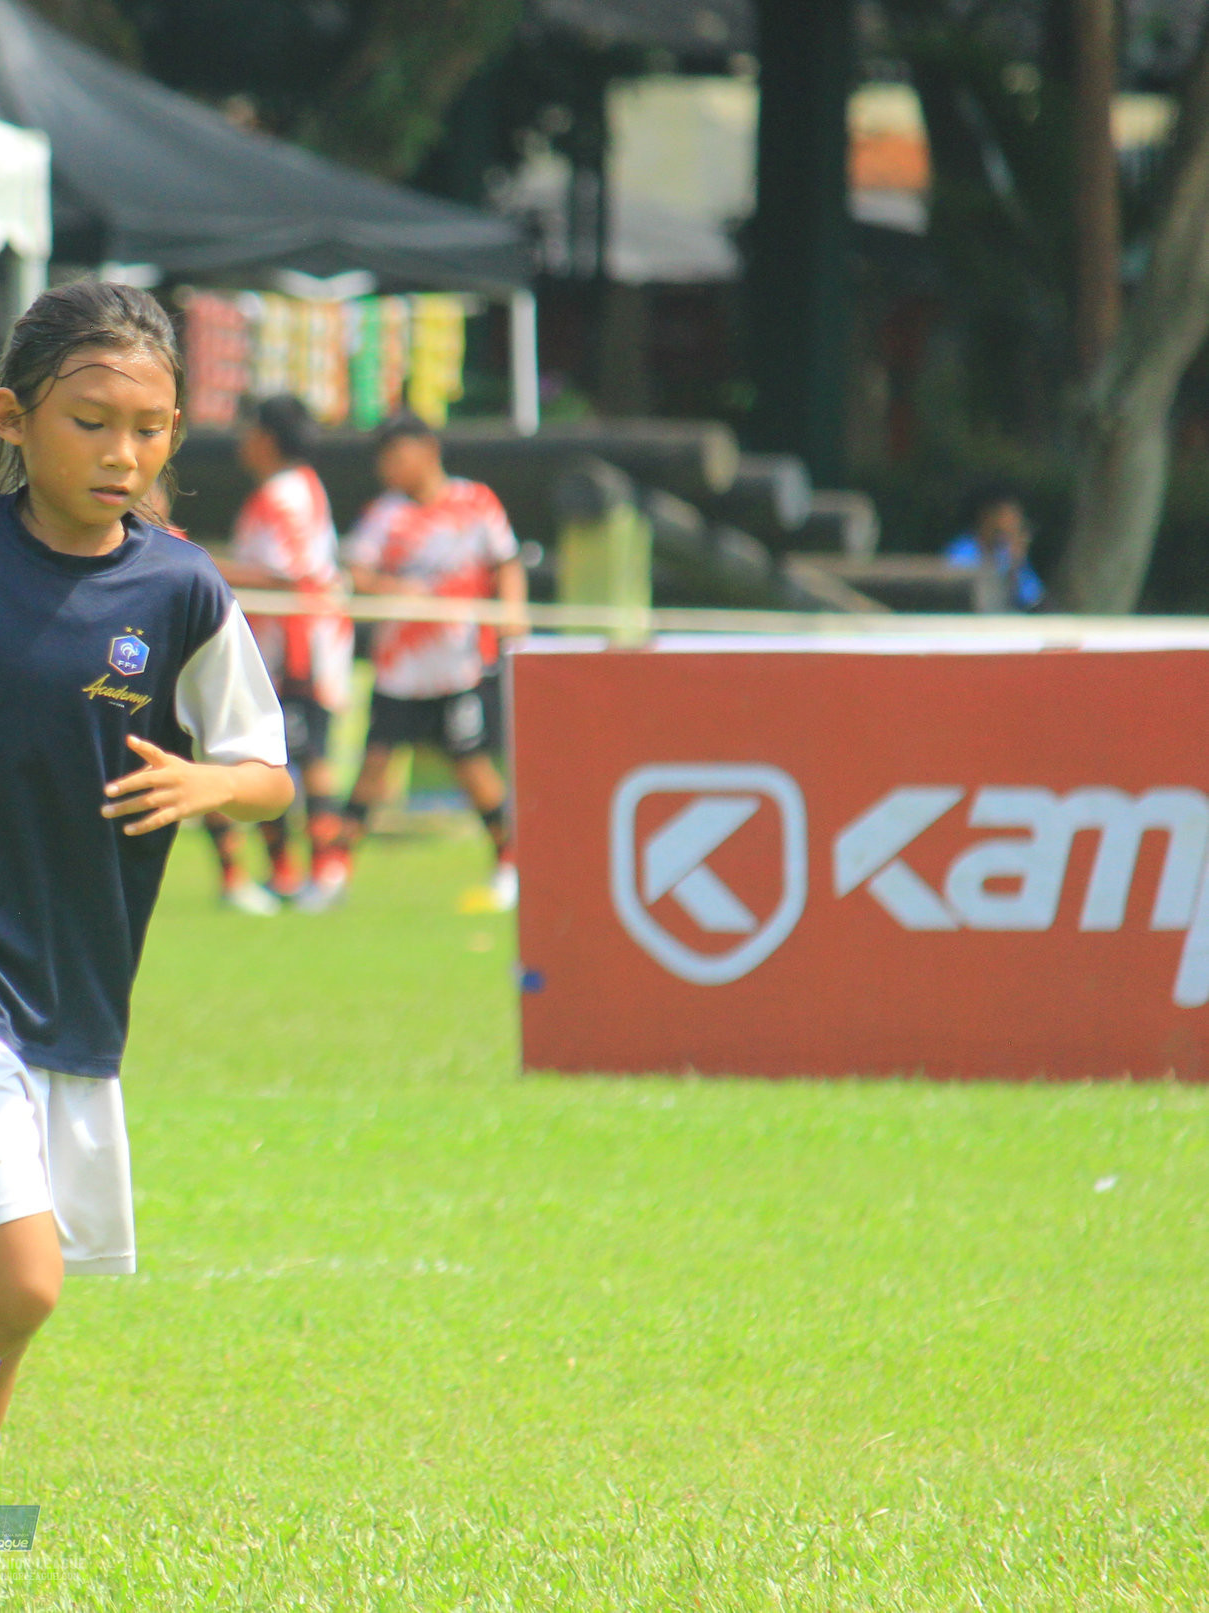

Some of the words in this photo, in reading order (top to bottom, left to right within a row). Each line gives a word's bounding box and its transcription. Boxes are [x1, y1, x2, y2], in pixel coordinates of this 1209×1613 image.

[118, 660, 138, 669] FFF
[82, 673, 152, 715] Academy
[832, 784, 1209, 1009] Kam
